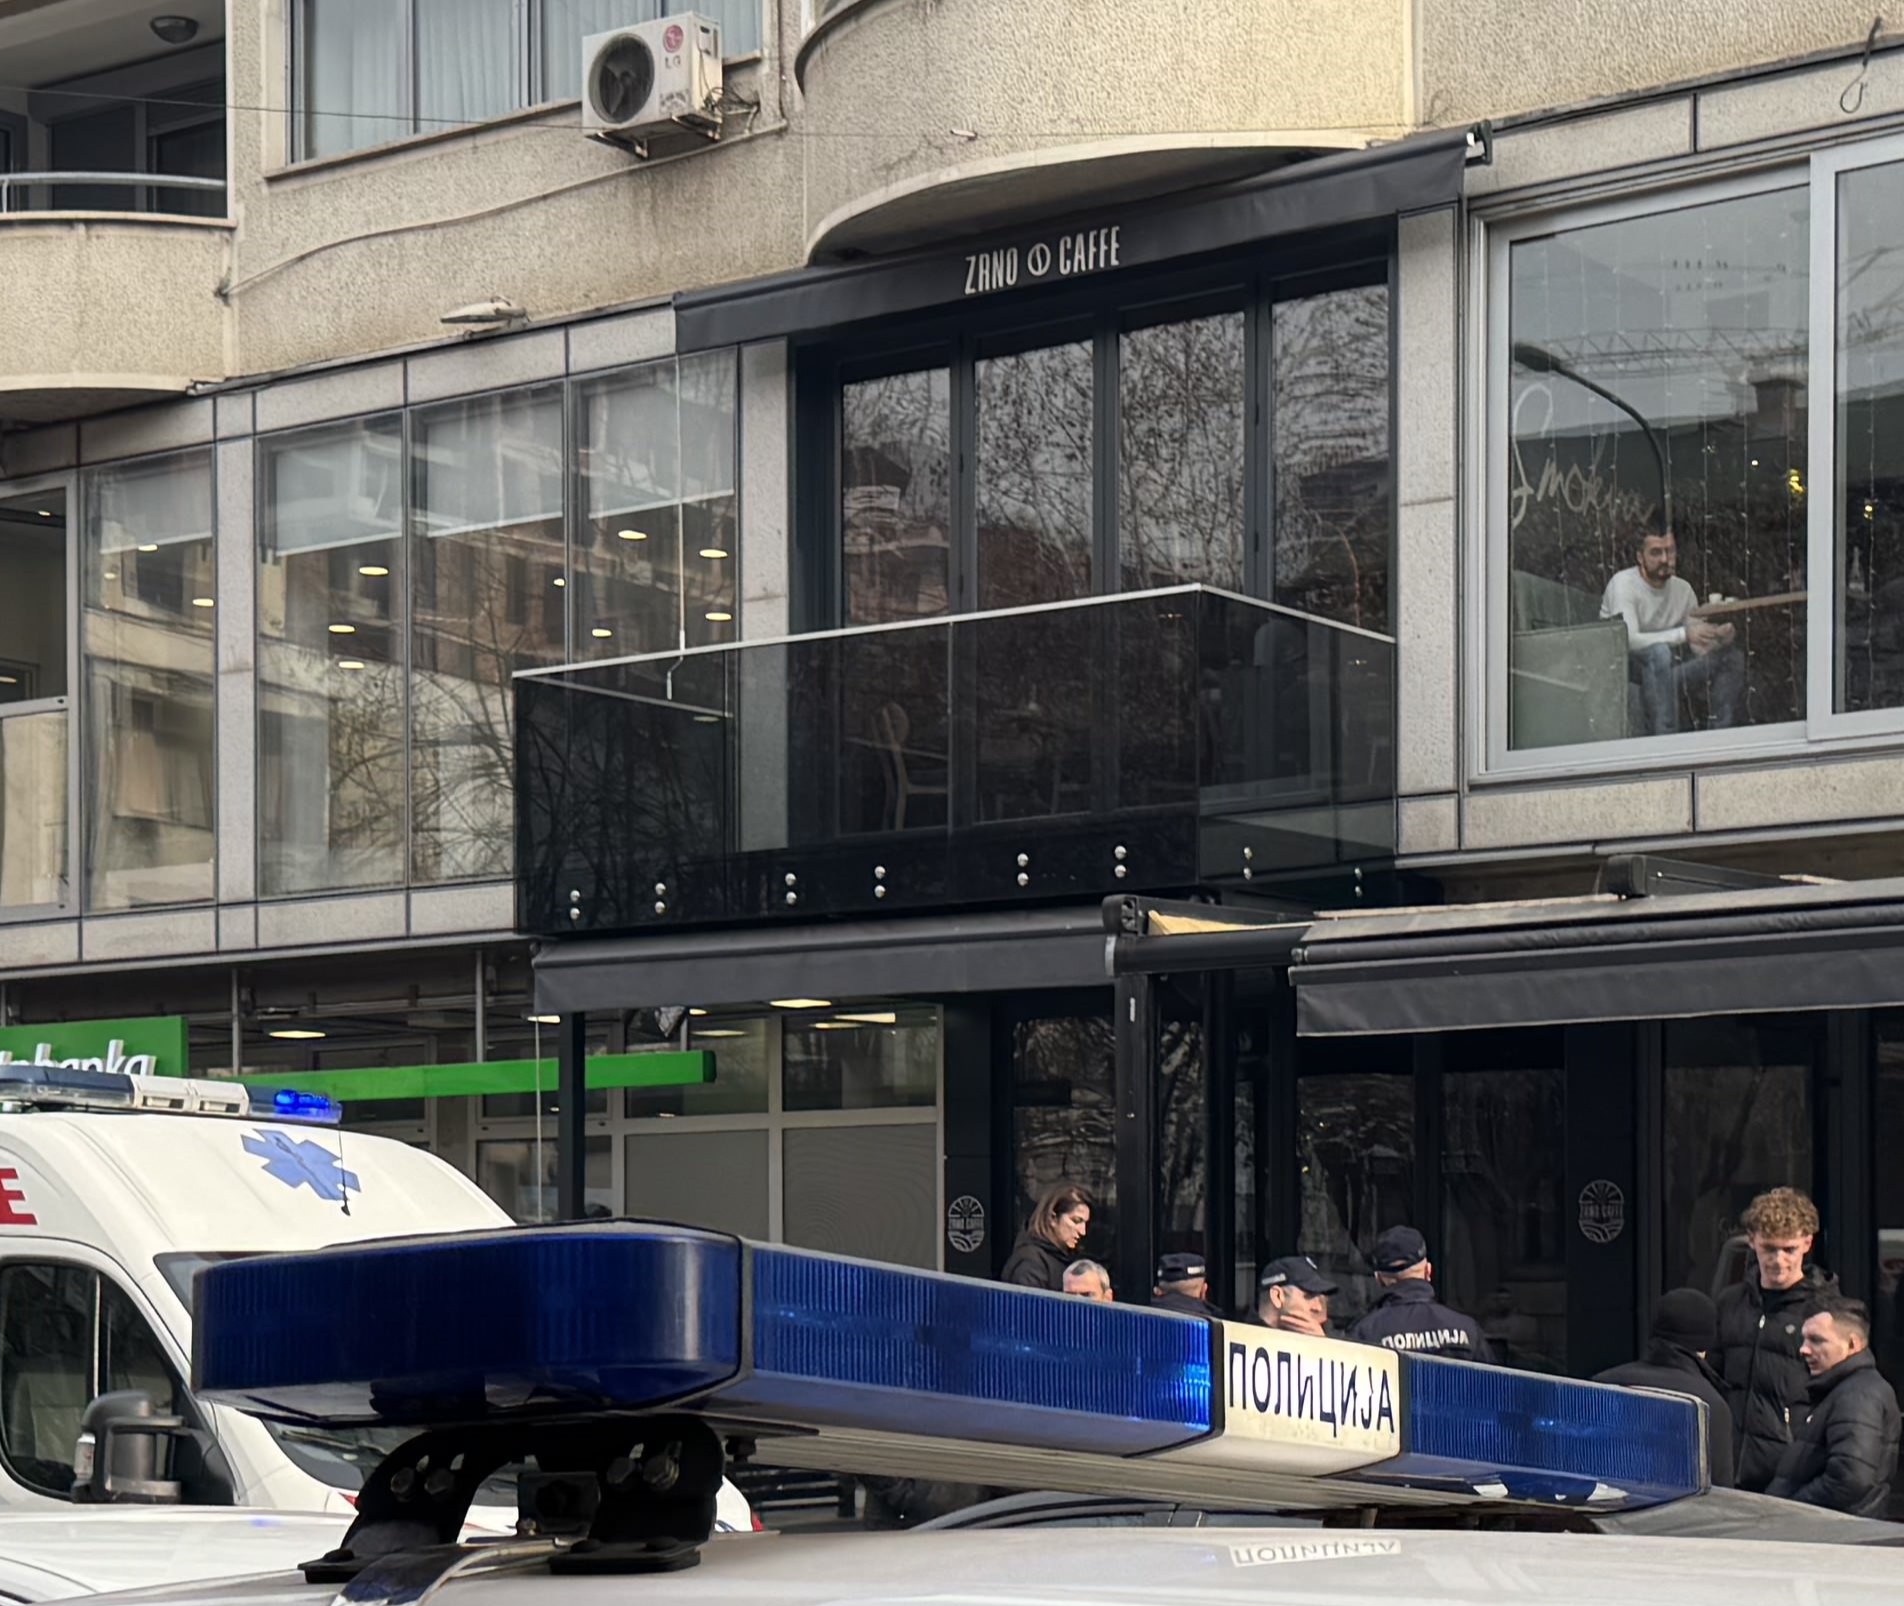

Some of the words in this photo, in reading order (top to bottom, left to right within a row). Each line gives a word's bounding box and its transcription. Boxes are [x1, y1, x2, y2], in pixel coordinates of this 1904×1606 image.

[665, 55, 682, 69] LG
[964, 246, 1018, 296] ZRNO
[1058, 226, 1121, 275] CAFFE
[1381, 1328, 1471, 1350] ПОЛИЦИЈА
[1229, 1341, 1395, 1438] ПОЛИЦИЈА
